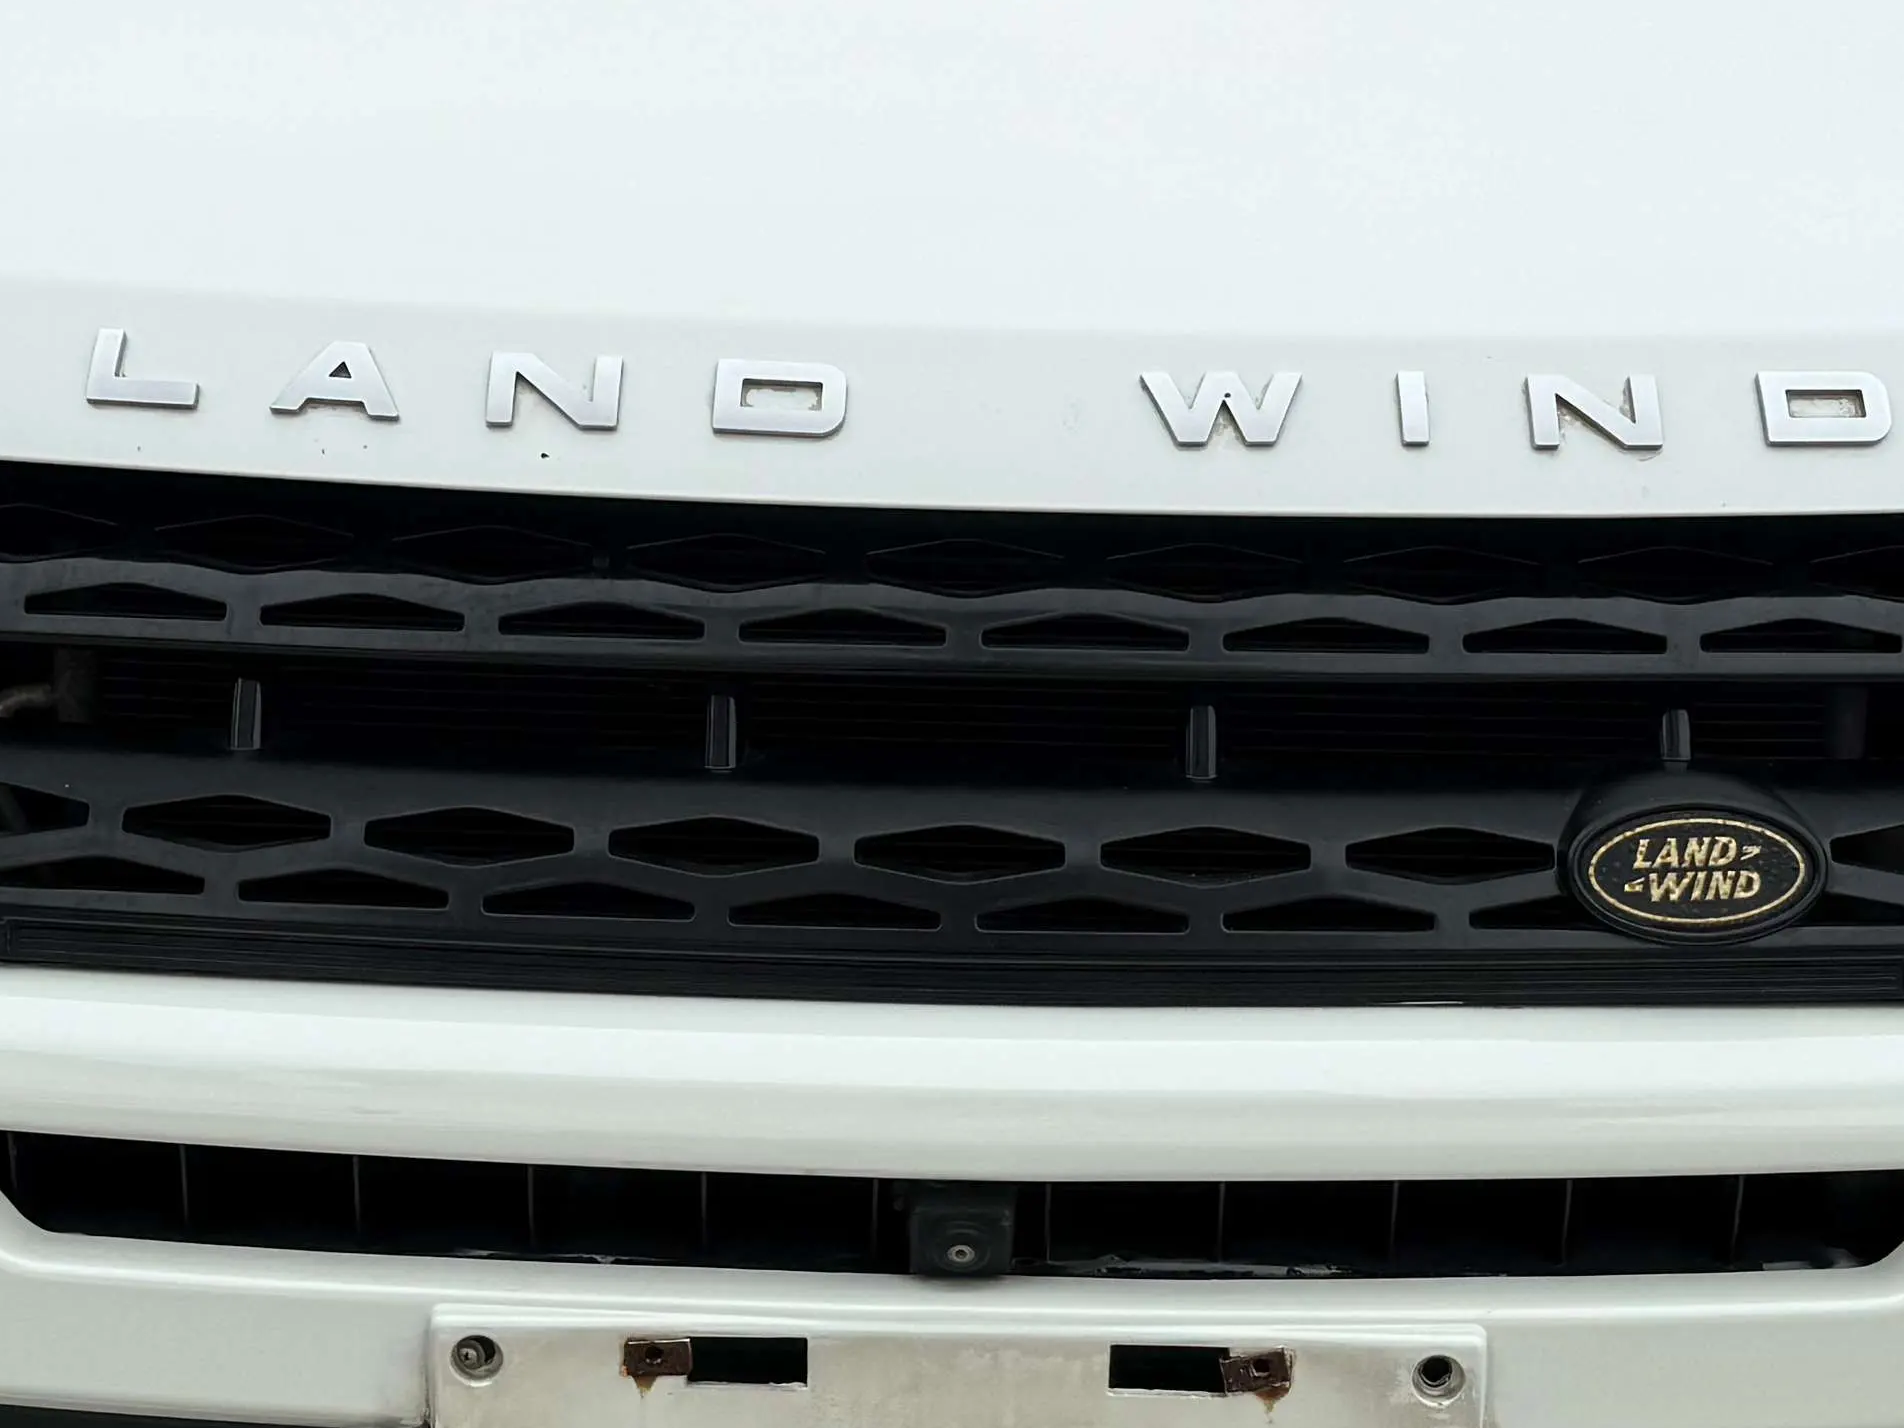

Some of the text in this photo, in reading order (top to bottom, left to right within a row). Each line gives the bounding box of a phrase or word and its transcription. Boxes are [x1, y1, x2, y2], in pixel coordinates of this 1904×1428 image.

[86, 328, 1894, 451] LAND WIND
[1632, 836, 1737, 869] LAND
[1648, 870, 1762, 902] WIND
